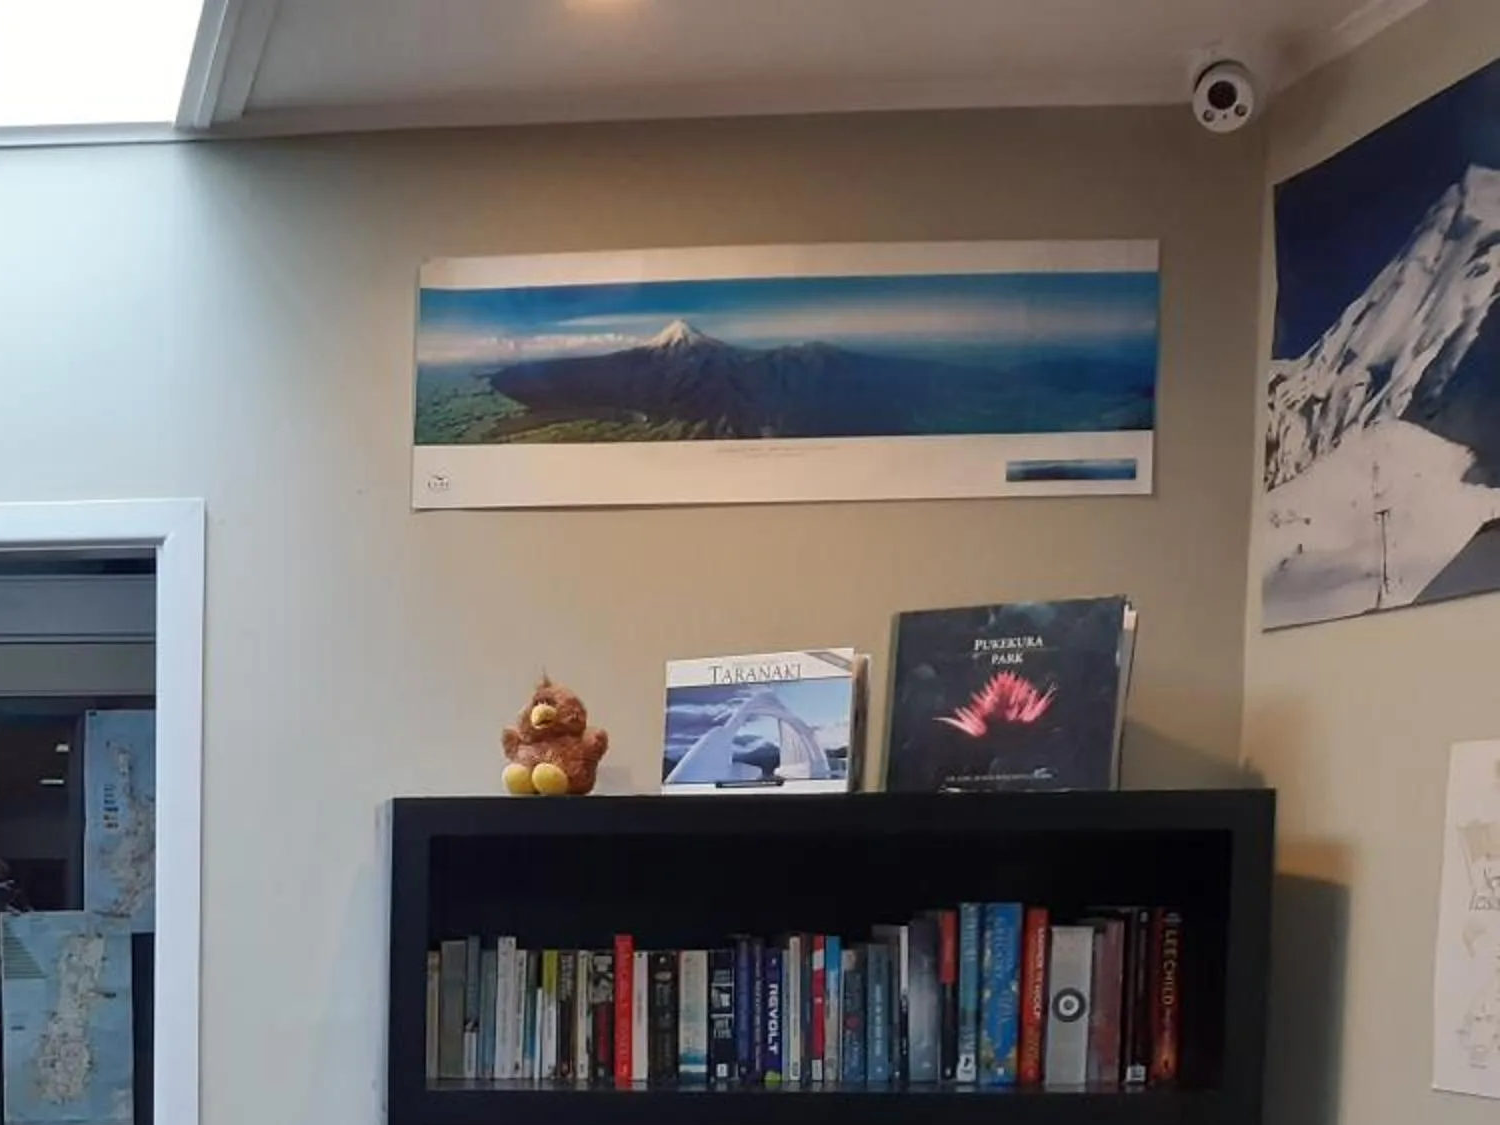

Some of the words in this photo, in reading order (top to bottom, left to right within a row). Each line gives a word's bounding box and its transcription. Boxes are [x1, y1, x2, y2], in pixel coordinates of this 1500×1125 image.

[991, 653, 1024, 665] PARK
[709, 662, 802, 685] TARANAKI
[1165, 929, 1179, 959] LEE
[1162, 960, 1177, 1005] CHILD
